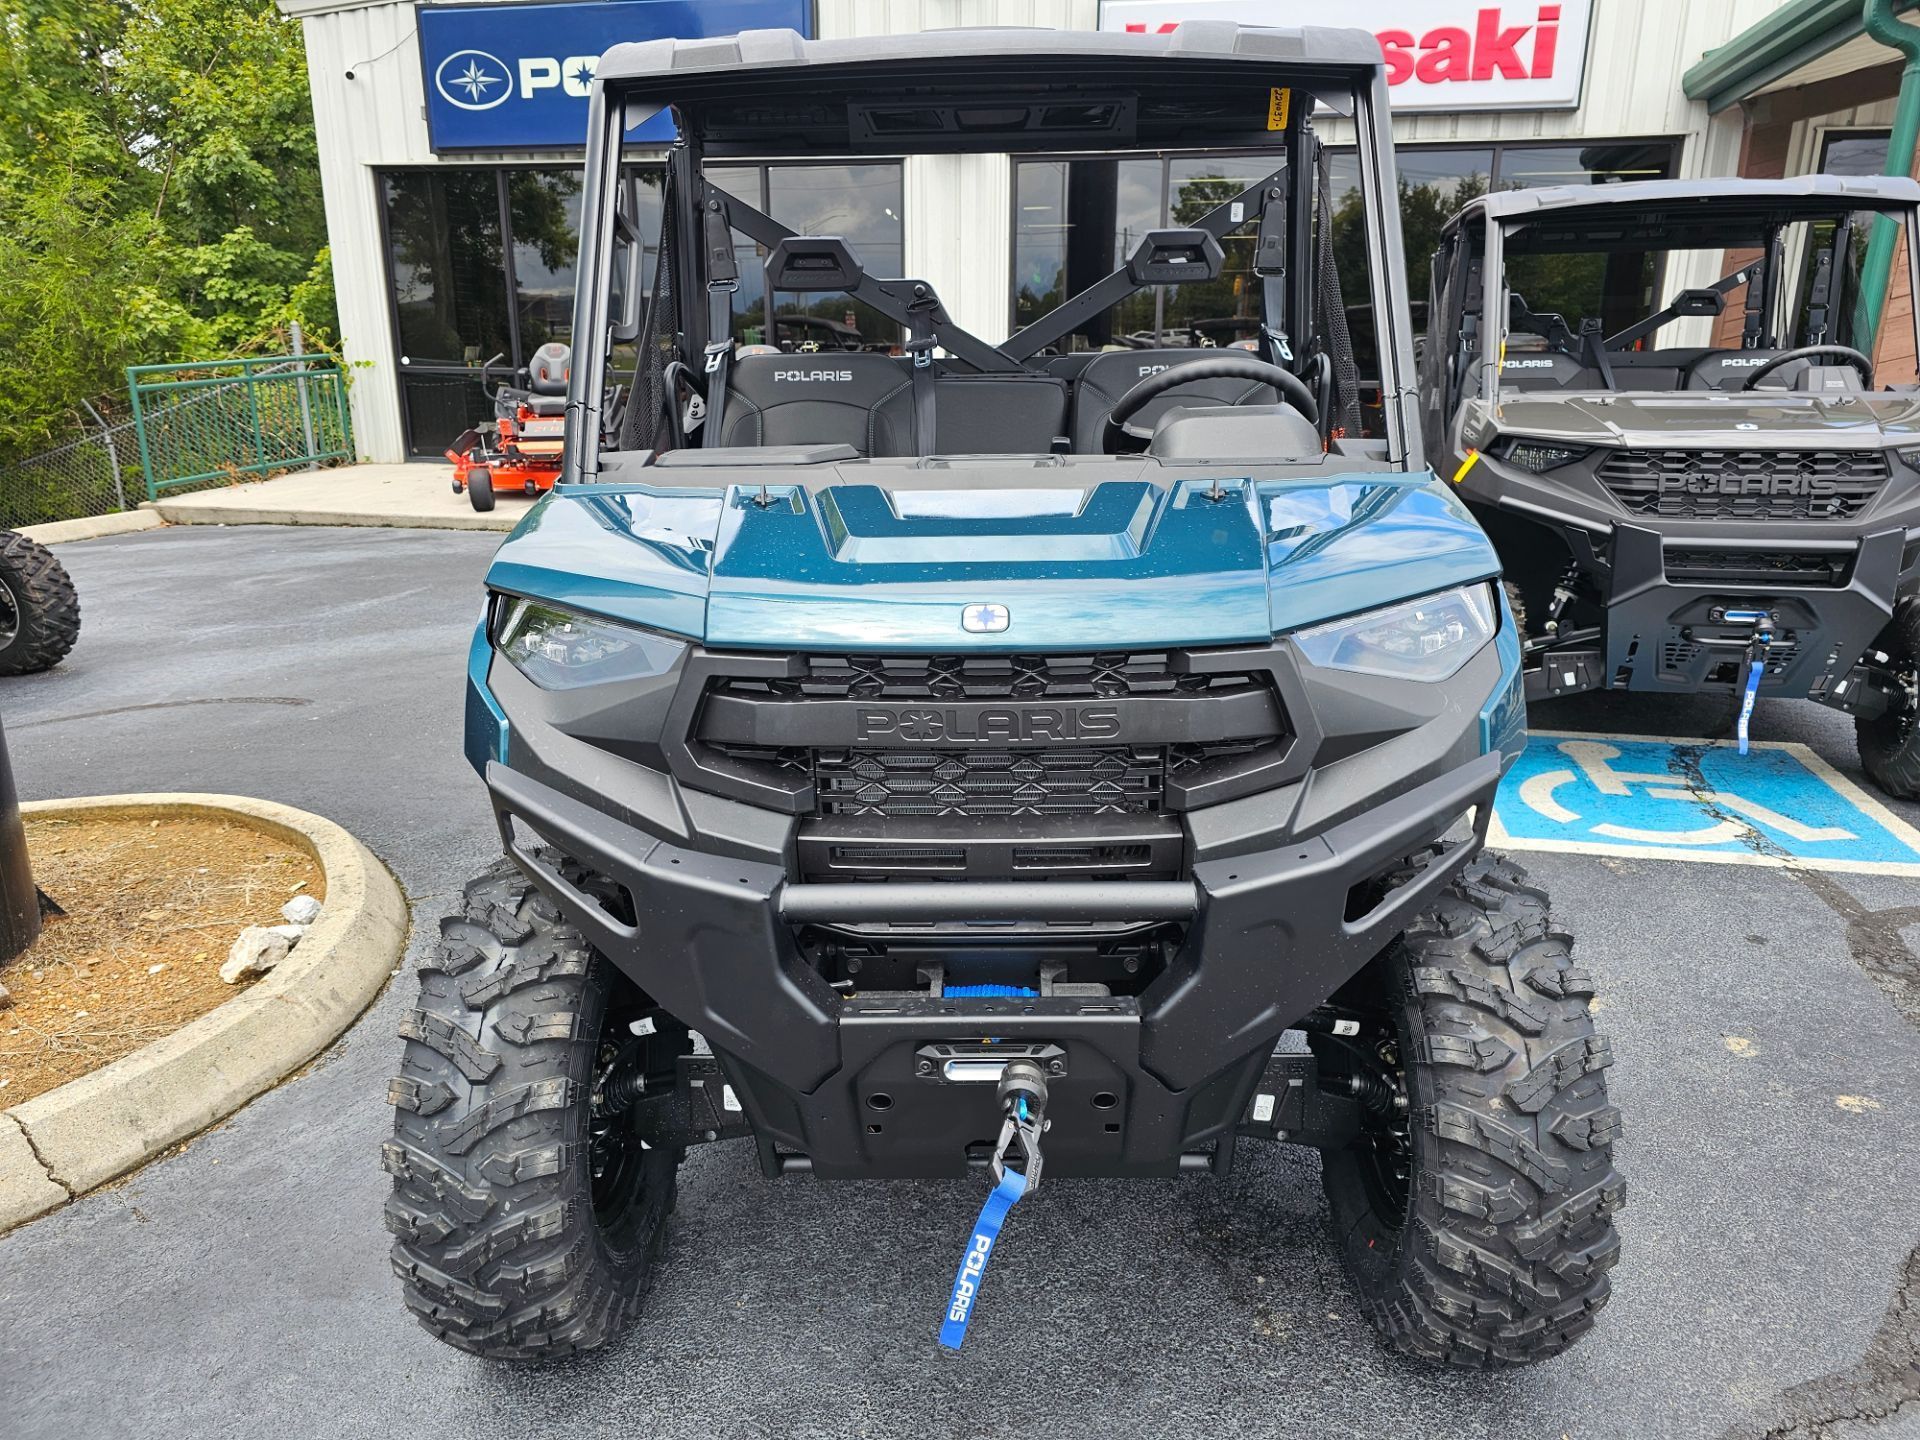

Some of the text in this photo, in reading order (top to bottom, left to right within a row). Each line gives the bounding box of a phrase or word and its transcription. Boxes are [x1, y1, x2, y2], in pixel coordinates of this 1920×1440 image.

[774, 370, 853, 382] POLARIS
[1658, 472, 1839, 496] POLARIS
[856, 707, 1121, 742] POLARIS
[949, 1234, 992, 1323] POLARIS
